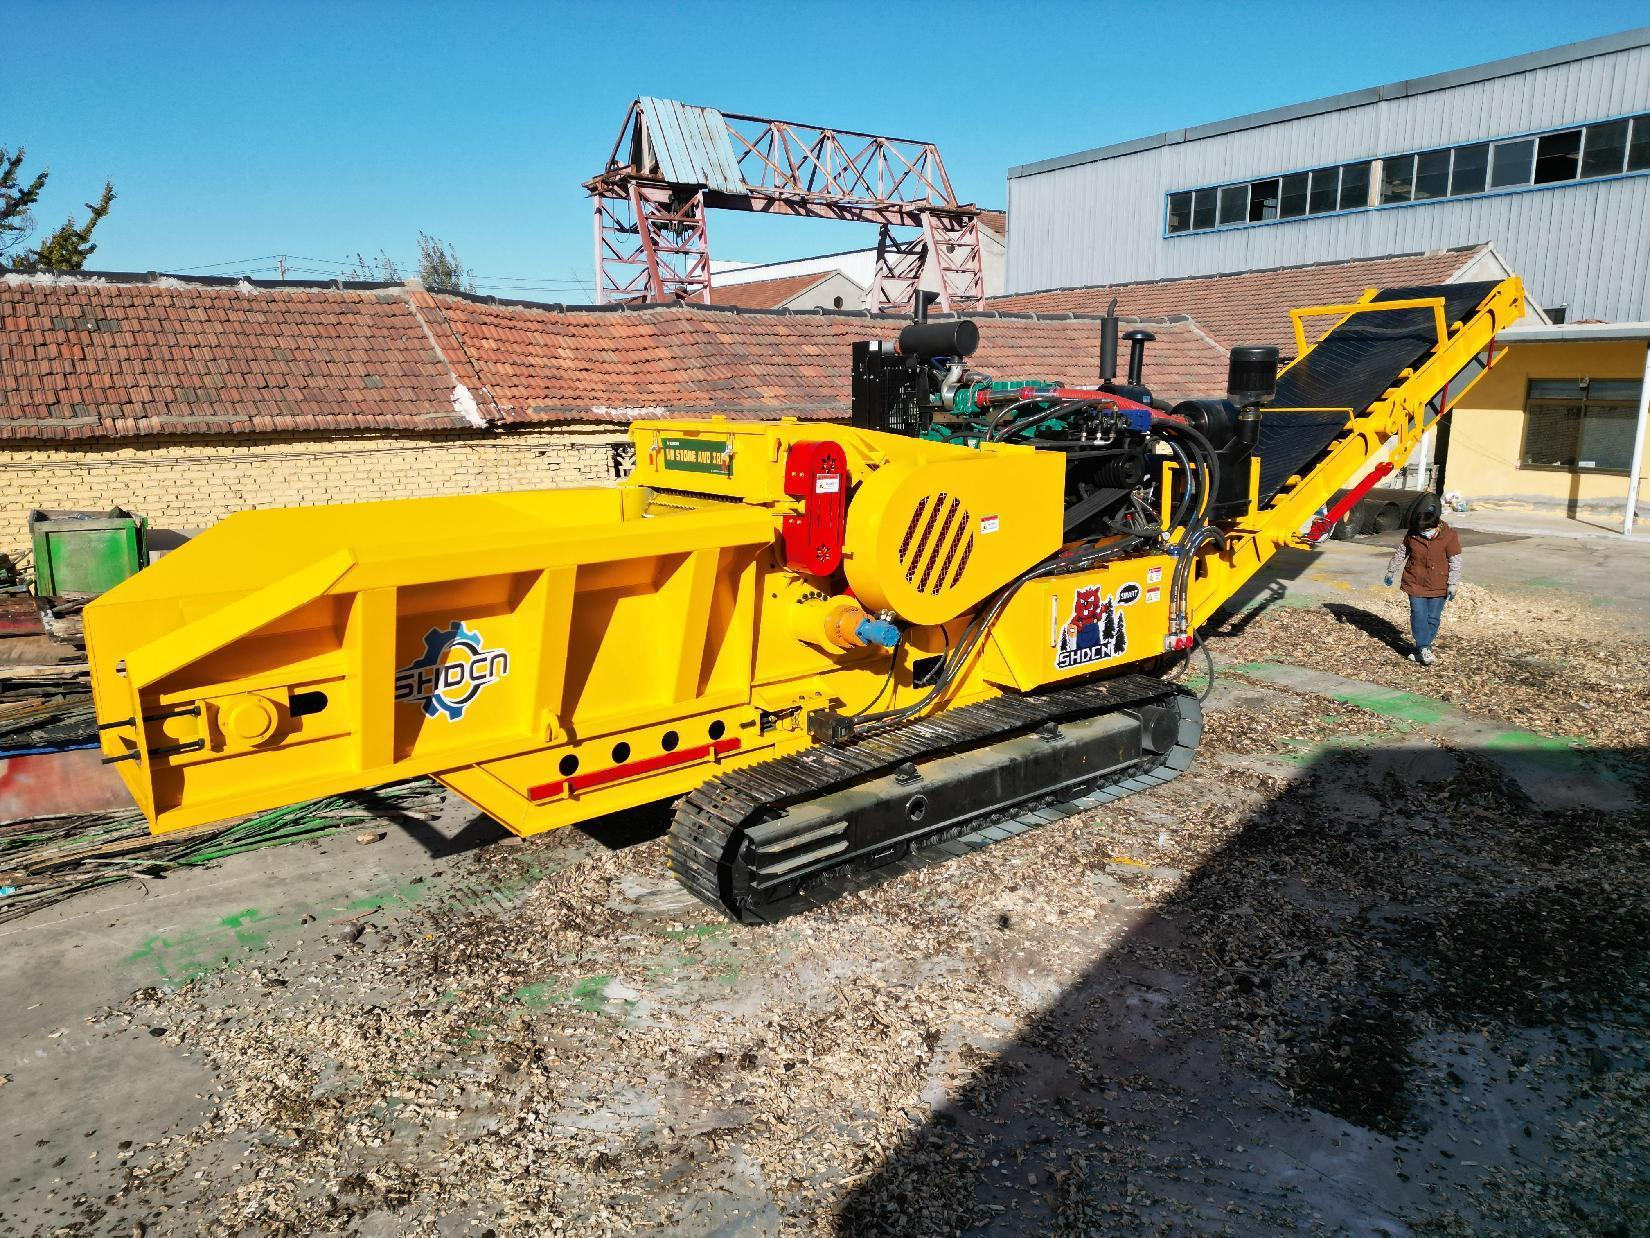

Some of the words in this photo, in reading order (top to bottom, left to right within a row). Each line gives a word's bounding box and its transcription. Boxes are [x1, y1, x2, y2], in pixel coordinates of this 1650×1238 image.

[675, 449, 696, 462] STONE
[697, 451, 711, 463] AND
[1059, 644, 1112, 667] SHDCN
